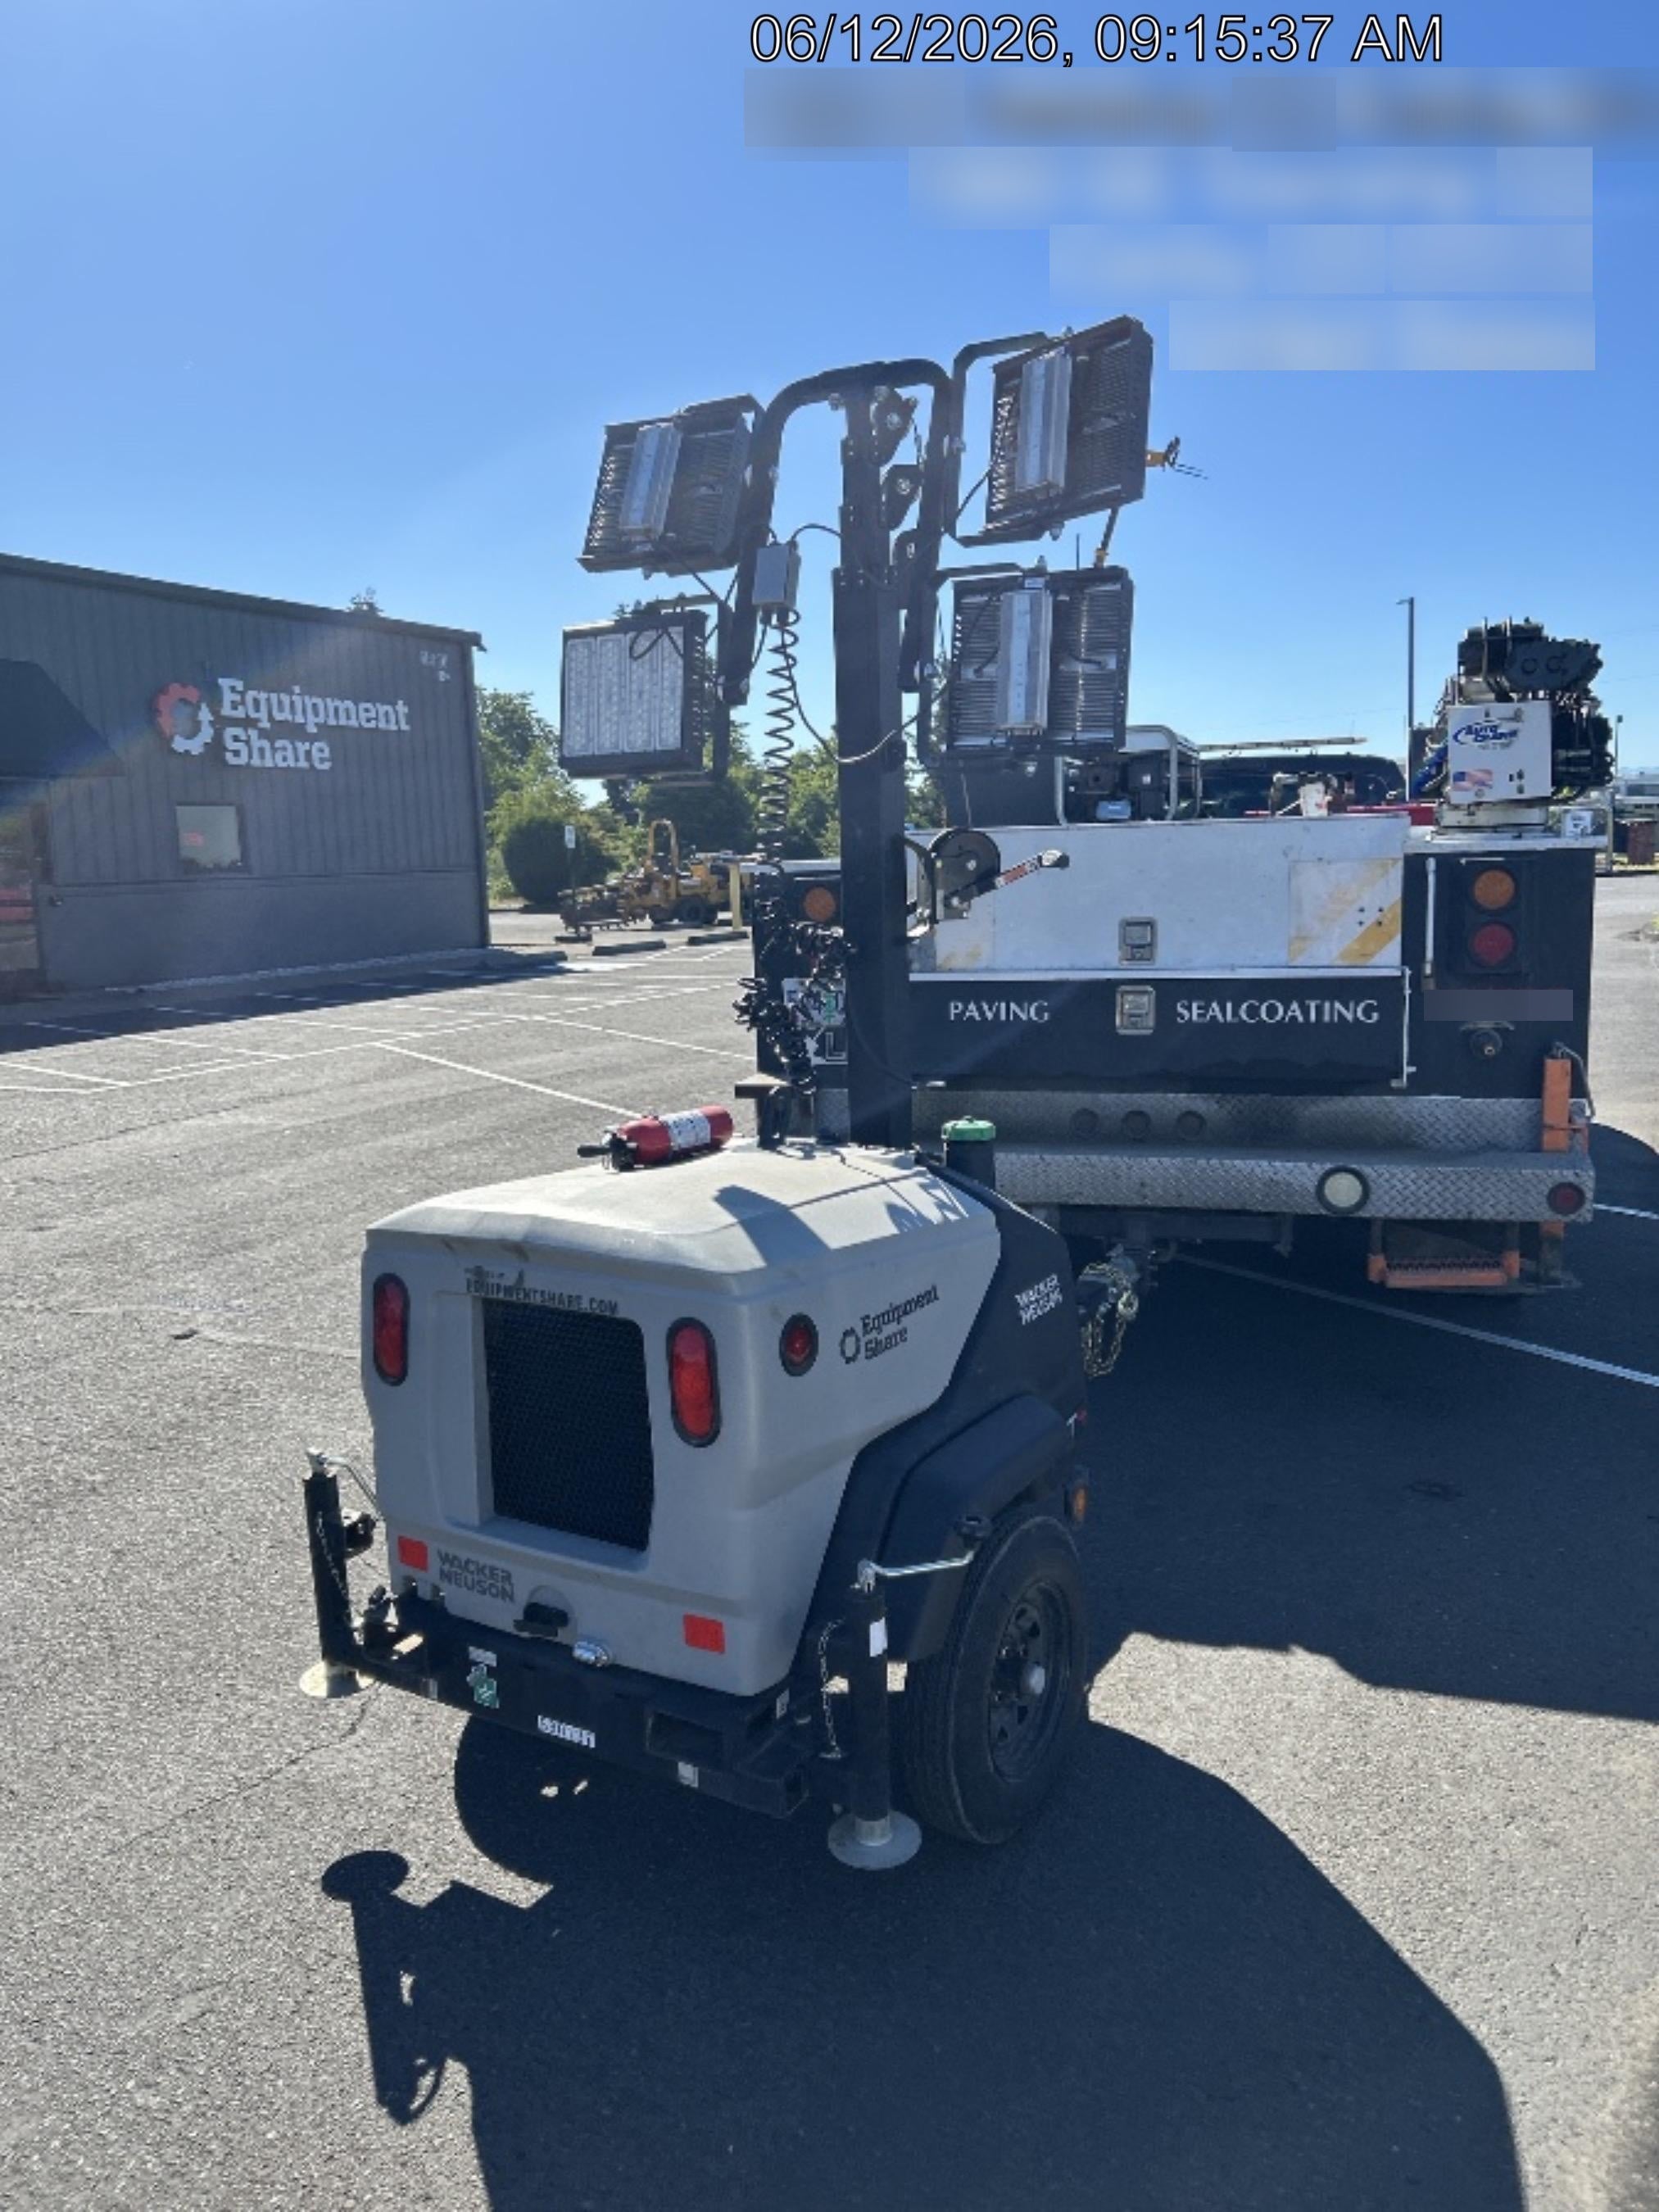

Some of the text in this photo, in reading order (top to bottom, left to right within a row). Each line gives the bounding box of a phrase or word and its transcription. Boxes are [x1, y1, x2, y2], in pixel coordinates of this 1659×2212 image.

[218, 678, 410, 733] Equipment
[224, 727, 332, 770] Share
[949, 999, 1380, 1024] PAVING SEALCOATING
[860, 1284, 940, 1337] Equipment
[863, 1326, 909, 1360] Share
[437, 1548, 512, 1586] WACKER
[439, 1566, 515, 1603] NEUSON
